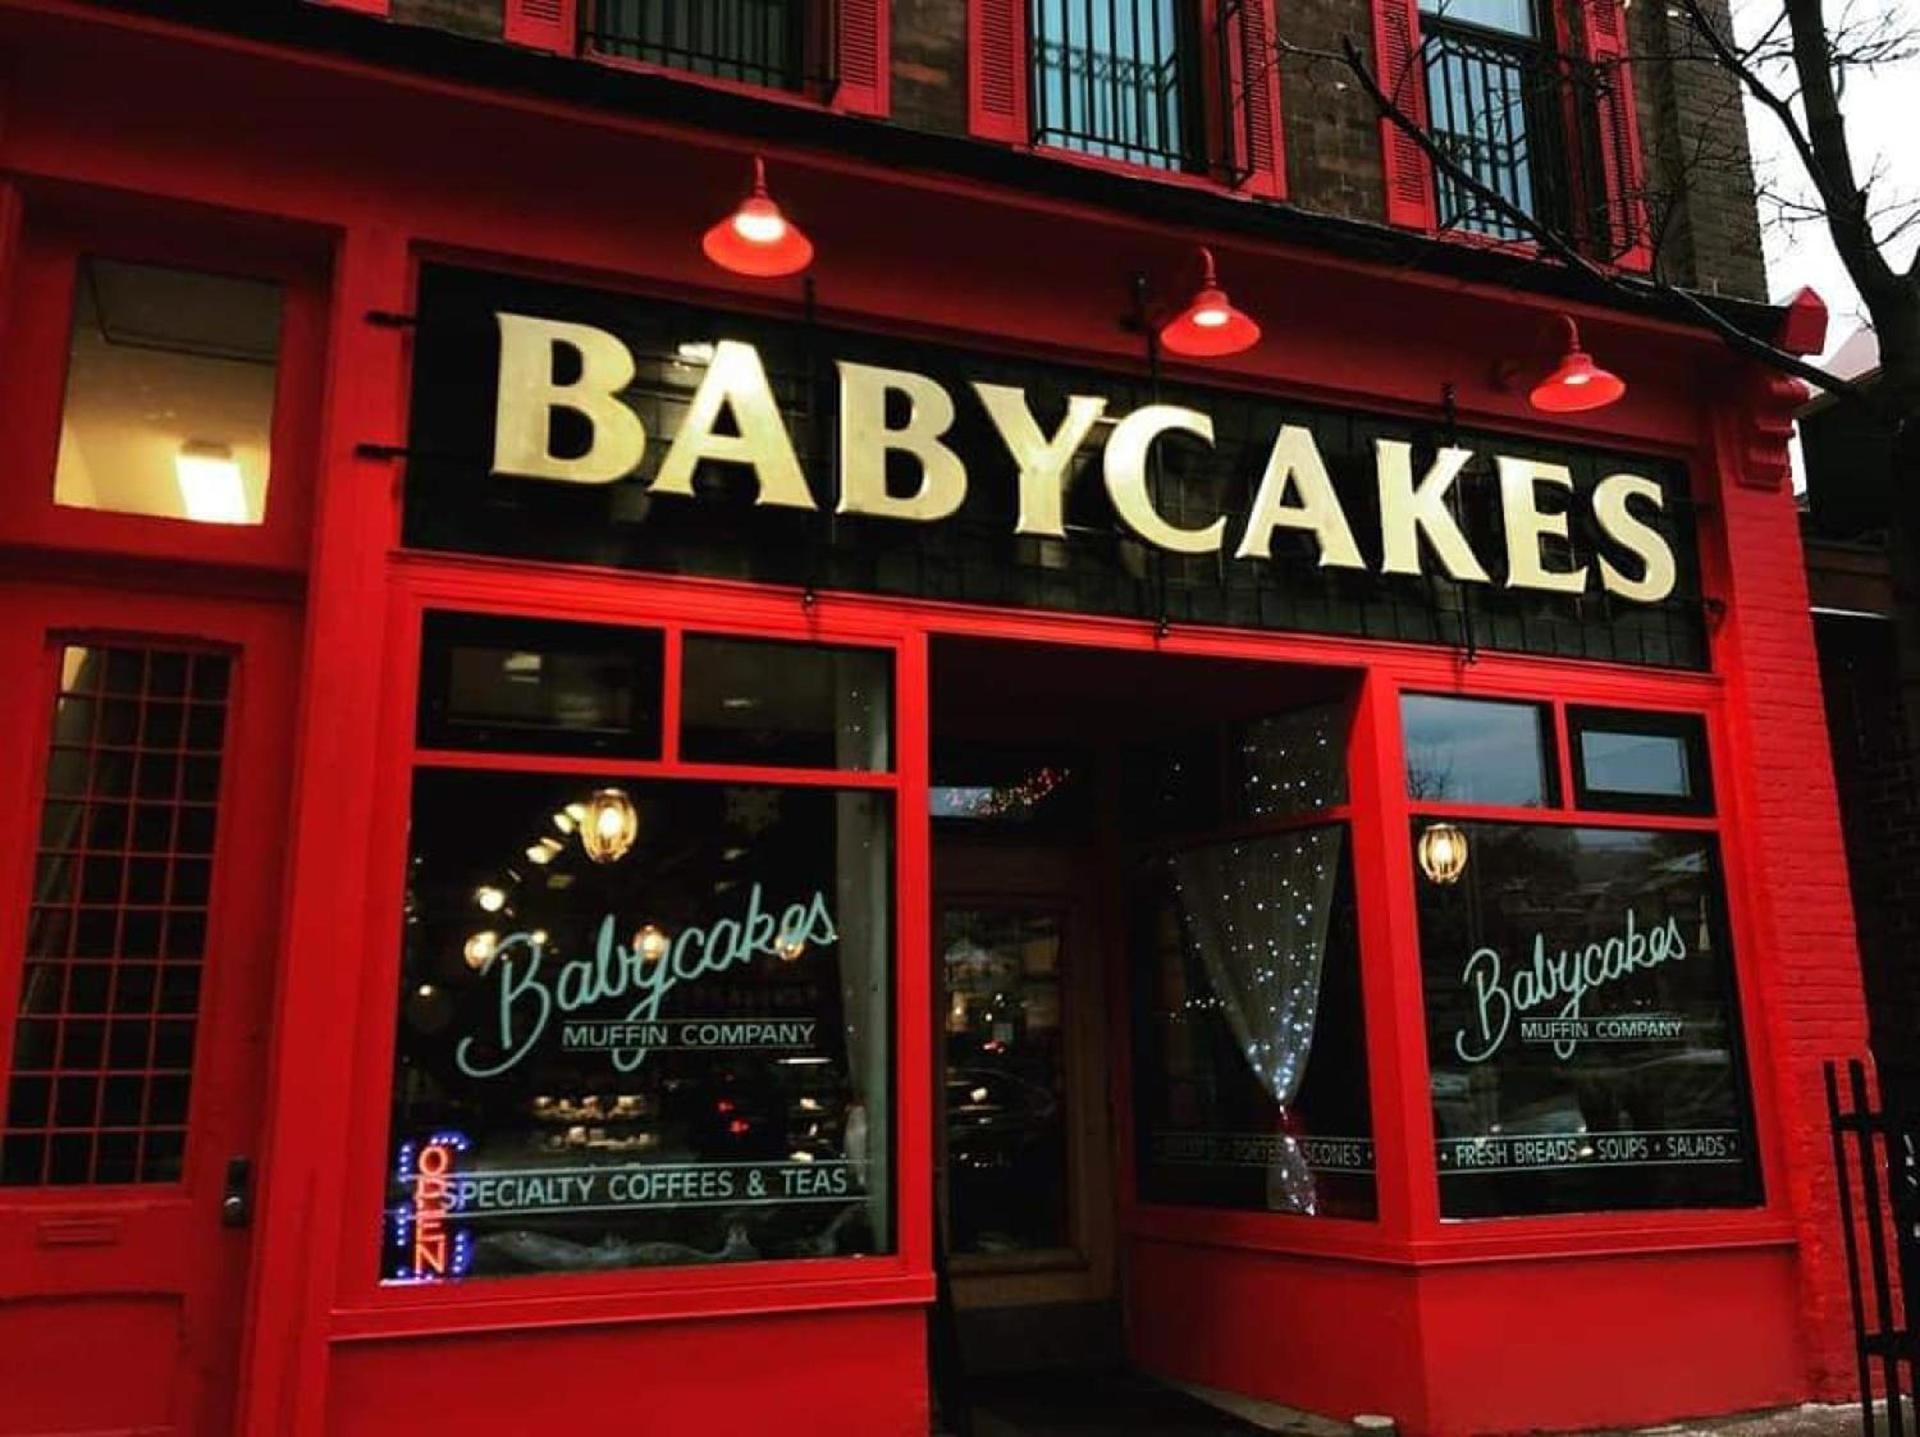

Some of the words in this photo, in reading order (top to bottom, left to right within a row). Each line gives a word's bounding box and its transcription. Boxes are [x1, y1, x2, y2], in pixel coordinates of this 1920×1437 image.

[491, 311, 1678, 603] BABYCAKES
[456, 882, 836, 1078] Babycakes
[1455, 908, 1688, 1063] Babycakes
[562, 1024, 668, 1047] MUFFIN
[681, 1022, 816, 1046] COMPANY
[1520, 1021, 1590, 1039] MUFFIN
[1595, 1020, 1683, 1039] COMPANY
[1302, 1142, 1362, 1166] SCONES
[1455, 1142, 1508, 1168] FRESH
[1514, 1139, 1578, 1164] BREADS
[1597, 1136, 1649, 1160] SOUPS
[1666, 1134, 1727, 1157] SALADS
[415, 1145, 449, 1274] OPEN
[439, 1174, 596, 1211] SPECIALTY
[608, 1169, 734, 1200] COFFEES
[746, 1168, 767, 1197] &
[779, 1167, 848, 1195] TEAS
